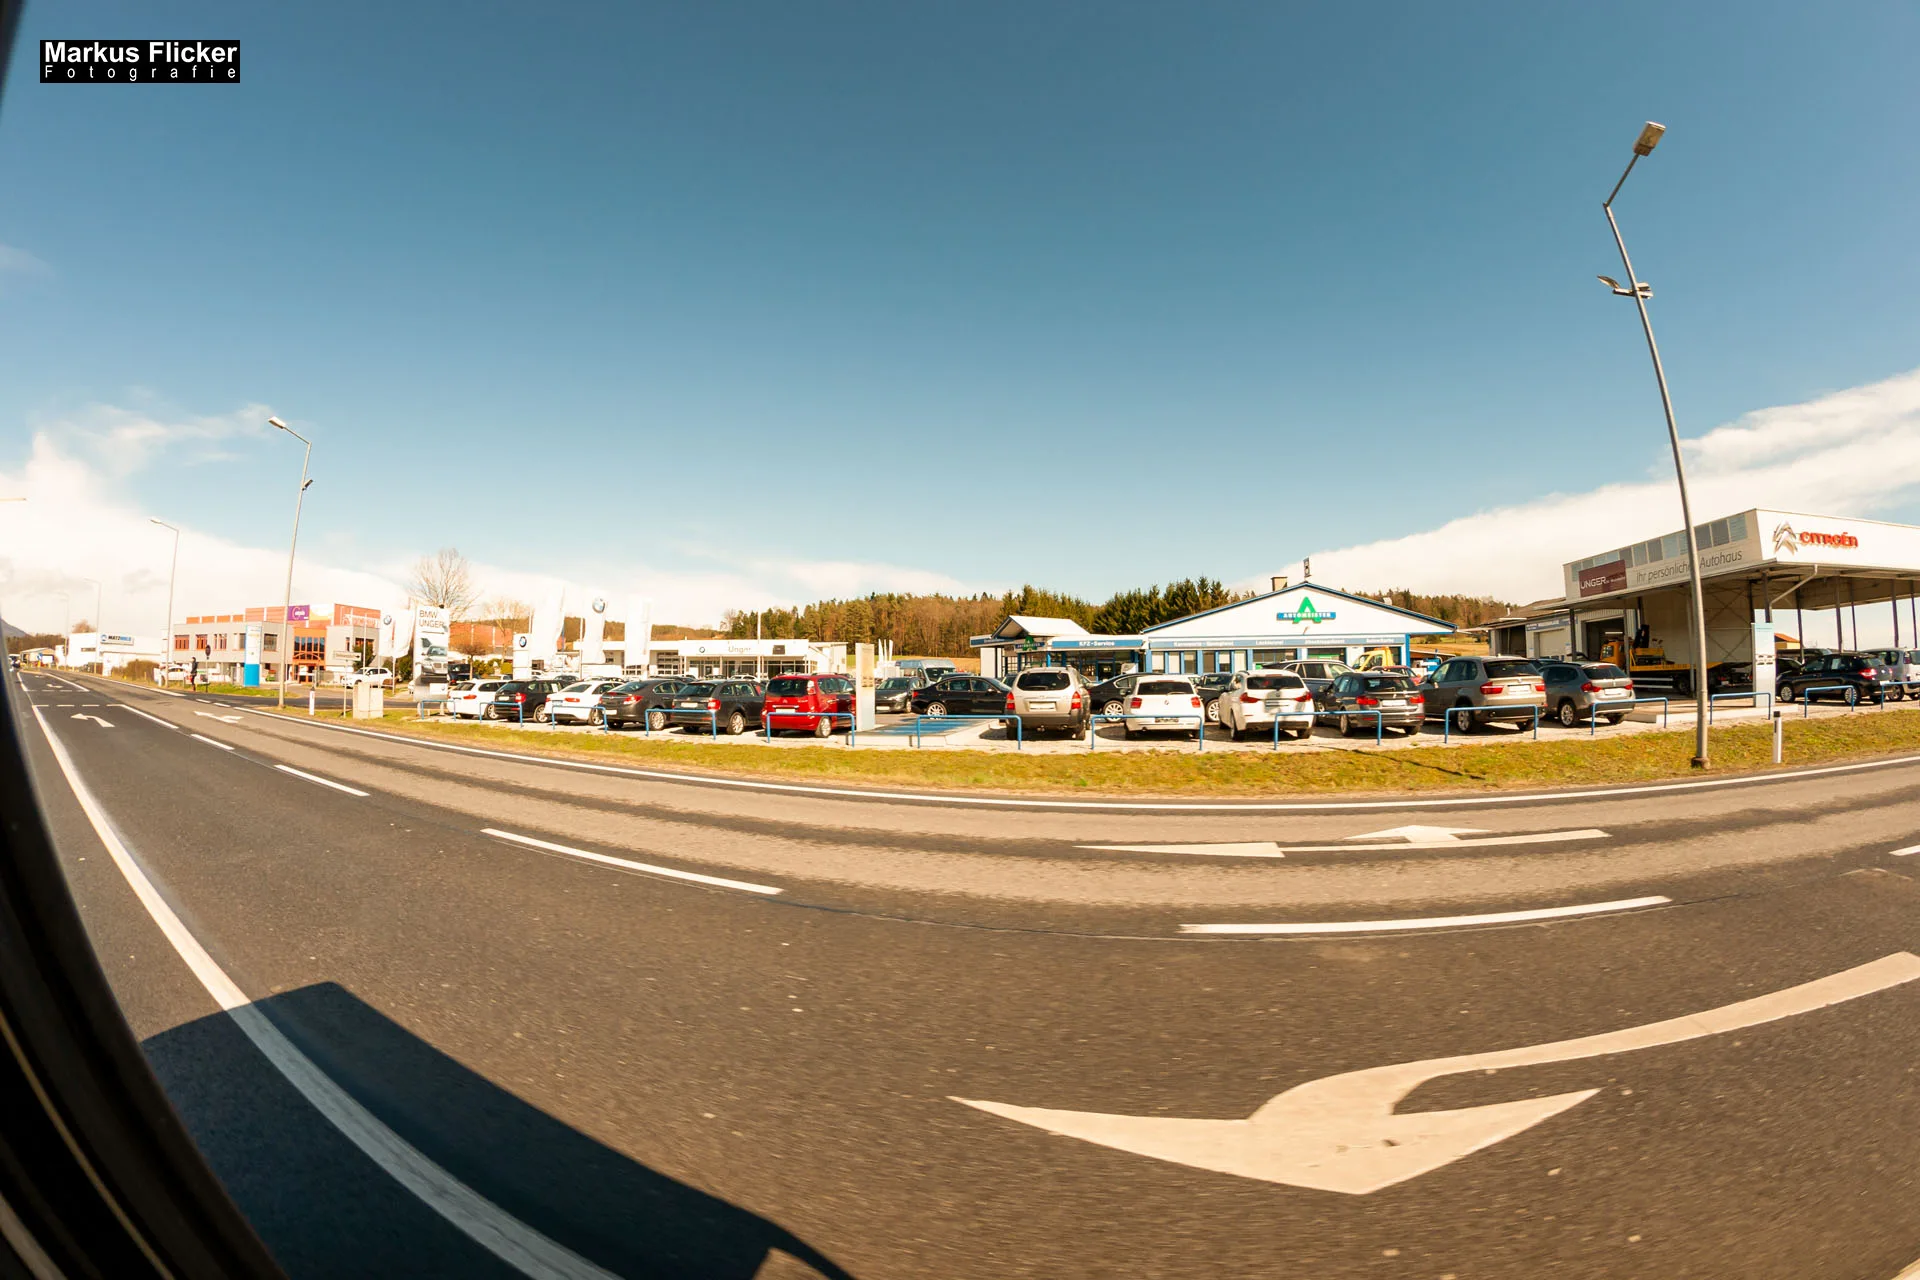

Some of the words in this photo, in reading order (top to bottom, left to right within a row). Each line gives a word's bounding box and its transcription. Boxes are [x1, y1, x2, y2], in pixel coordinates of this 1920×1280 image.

[1699, 550, 1743, 569] Autohaus
[1581, 576, 1606, 589] UNGER
[419, 609, 438, 619] BMW
[418, 618, 444, 629] UNGER
